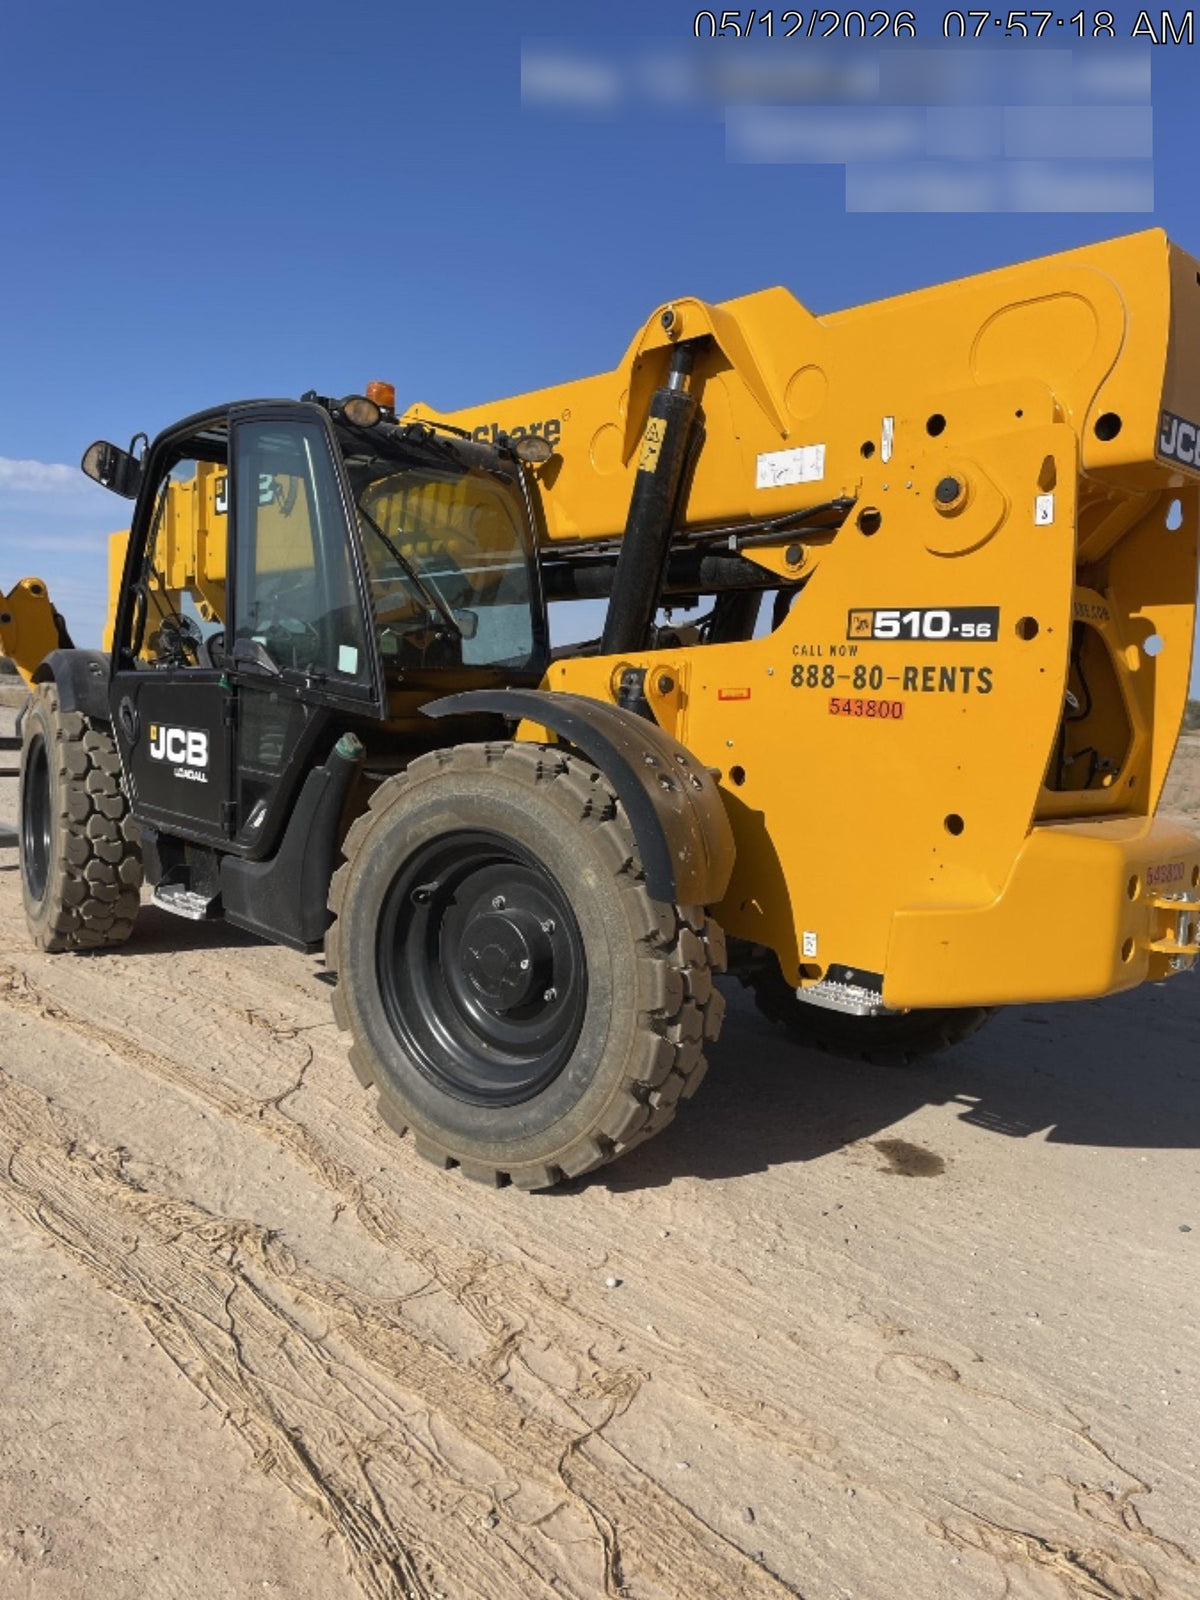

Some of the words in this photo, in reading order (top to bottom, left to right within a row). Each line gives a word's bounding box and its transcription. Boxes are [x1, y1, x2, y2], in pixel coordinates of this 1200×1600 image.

[1160, 418, 1200, 467] JC
[873, 610, 992, 638] 510-56
[792, 645, 823, 657] CALL
[829, 645, 858, 657] NOW
[790, 664, 994, 694] 888-80-RENTS
[829, 697, 904, 719] 543800
[150, 726, 209, 767] JCB
